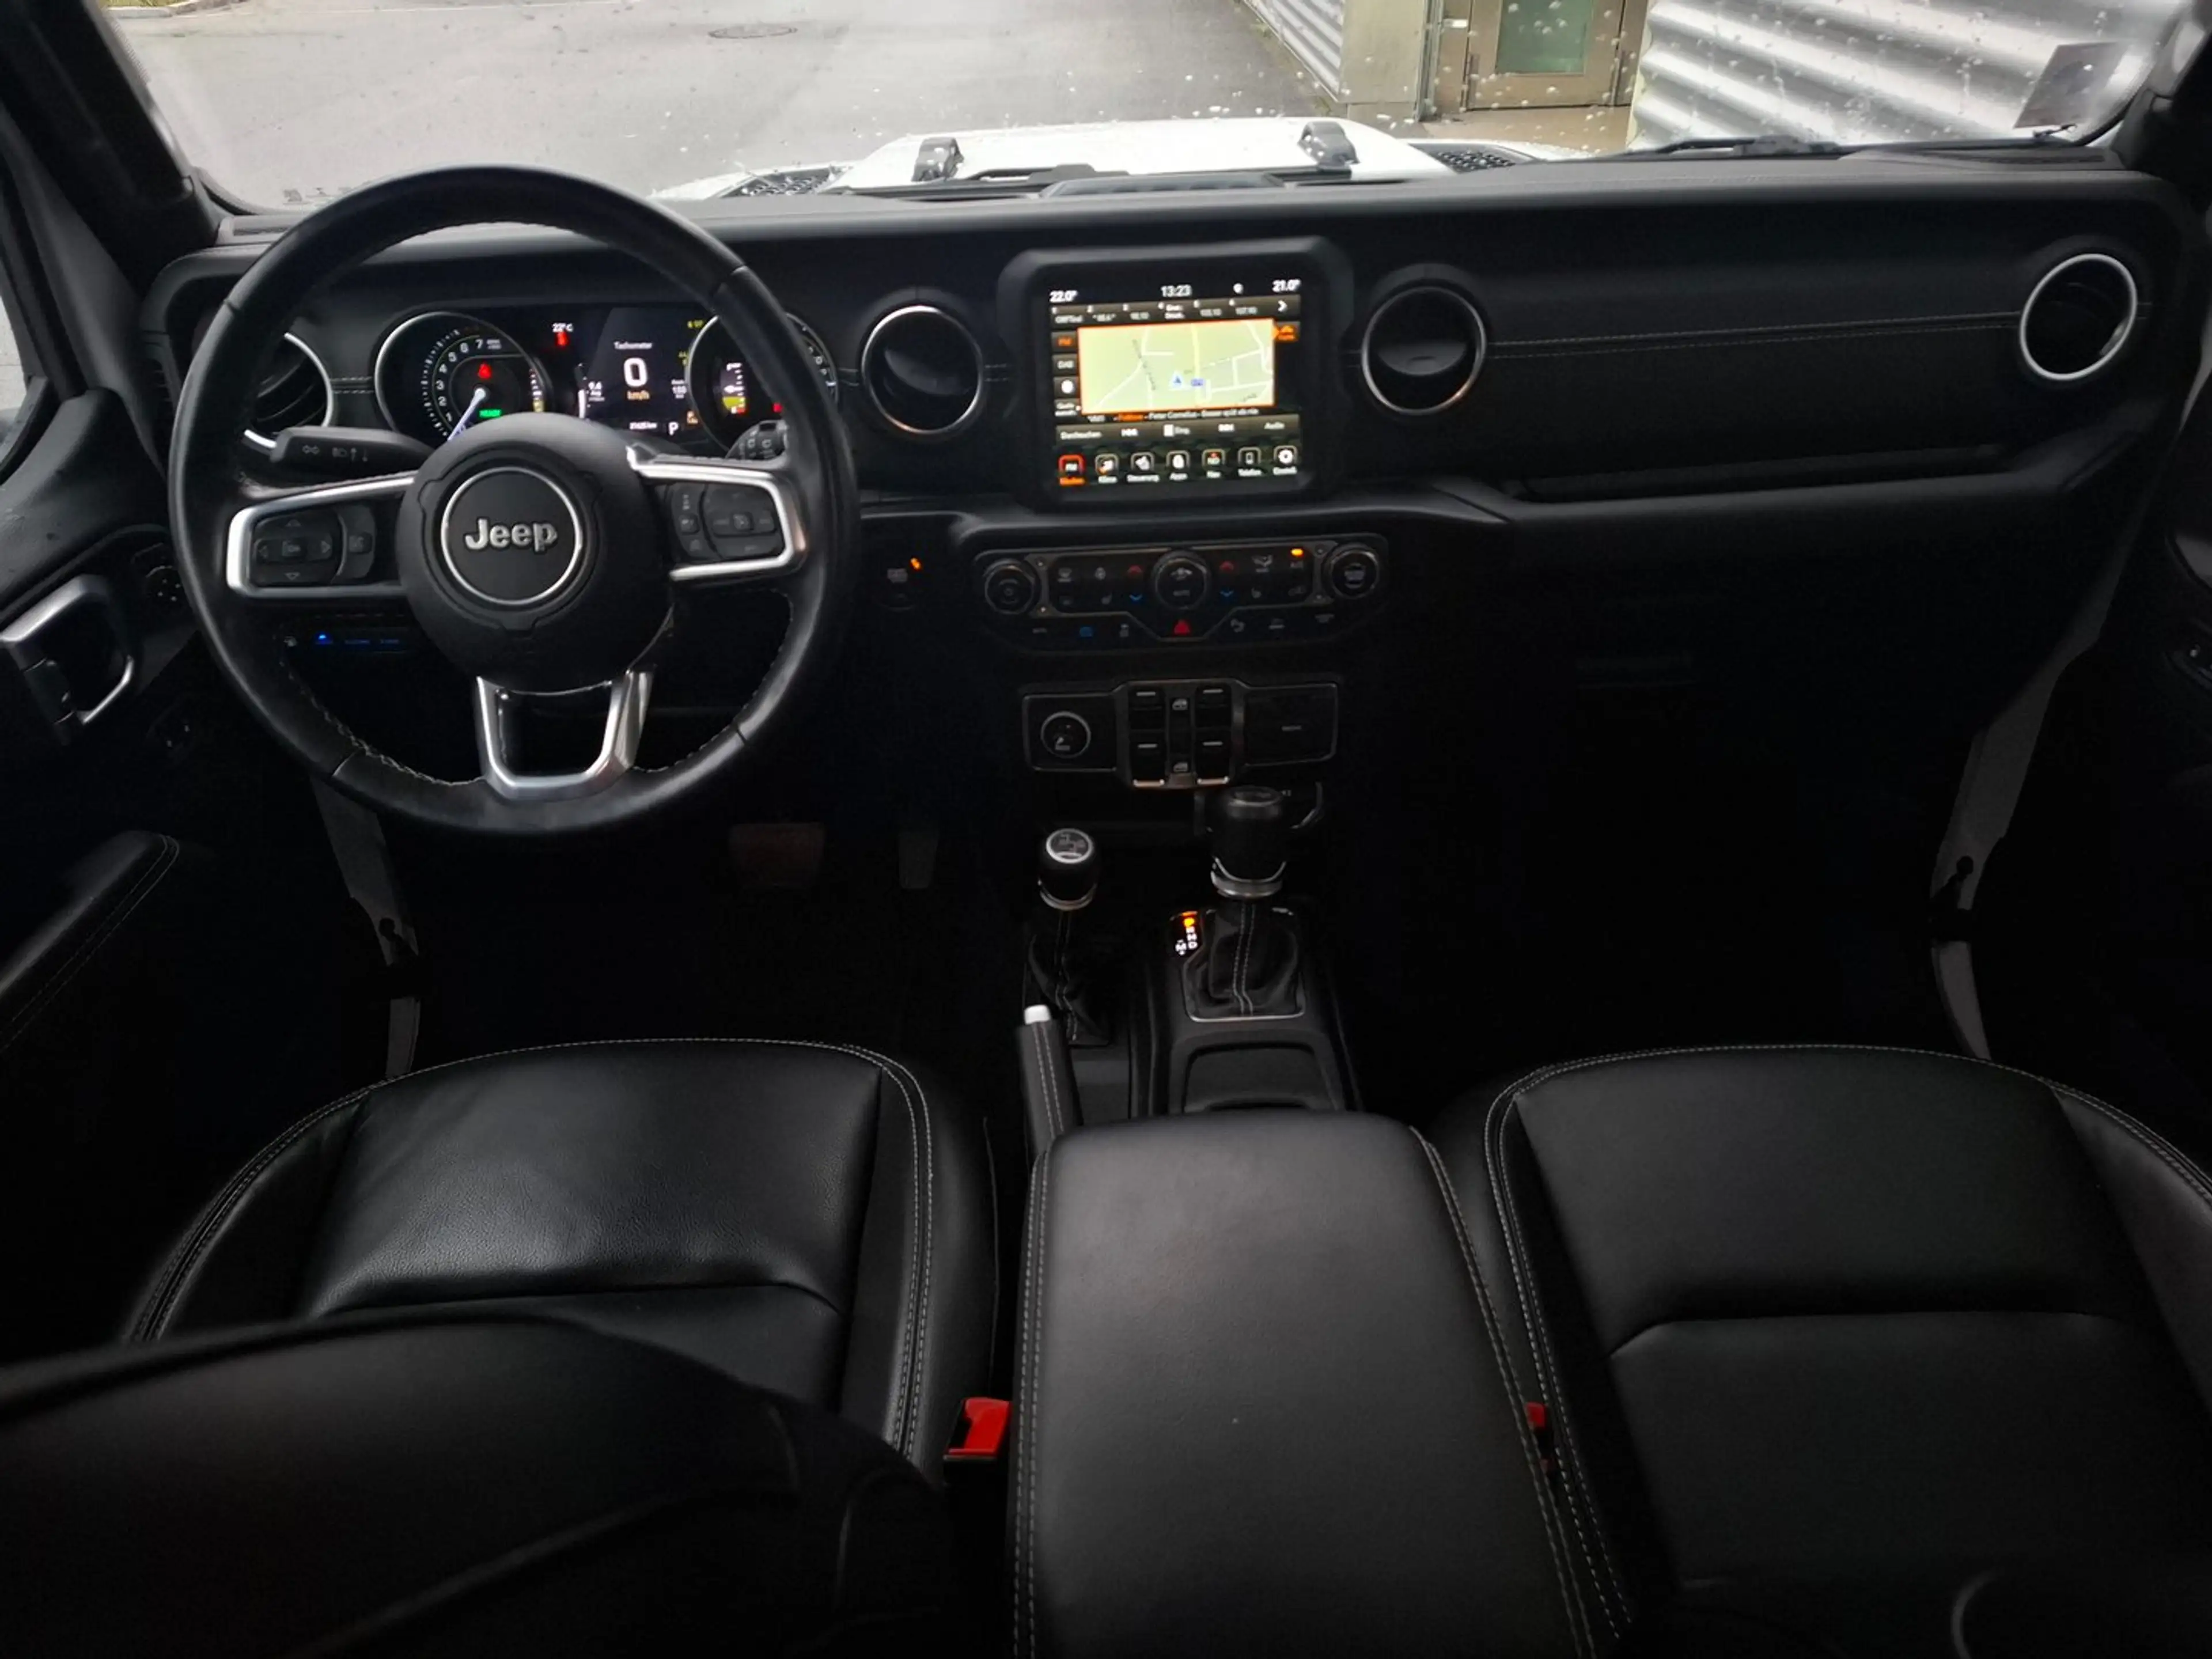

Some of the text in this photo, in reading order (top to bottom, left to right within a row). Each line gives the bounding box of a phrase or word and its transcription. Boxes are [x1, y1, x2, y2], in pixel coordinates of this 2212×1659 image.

[1161, 285, 1192, 297] 13:23
[1272, 279, 1301, 293] 21.0°
[1050, 290, 1078, 303] 22.0°
[460, 342, 469, 353] 6
[475, 339, 483, 349] 7
[448, 351, 457, 362] 5
[439, 363, 448, 374] 4
[624, 357, 647, 387] 0
[435, 380, 445, 391] 3
[438, 396, 447, 407] 2
[445, 412, 452, 422] 1
[669, 421, 679, 435] P
[465, 518, 558, 552] Jeep
